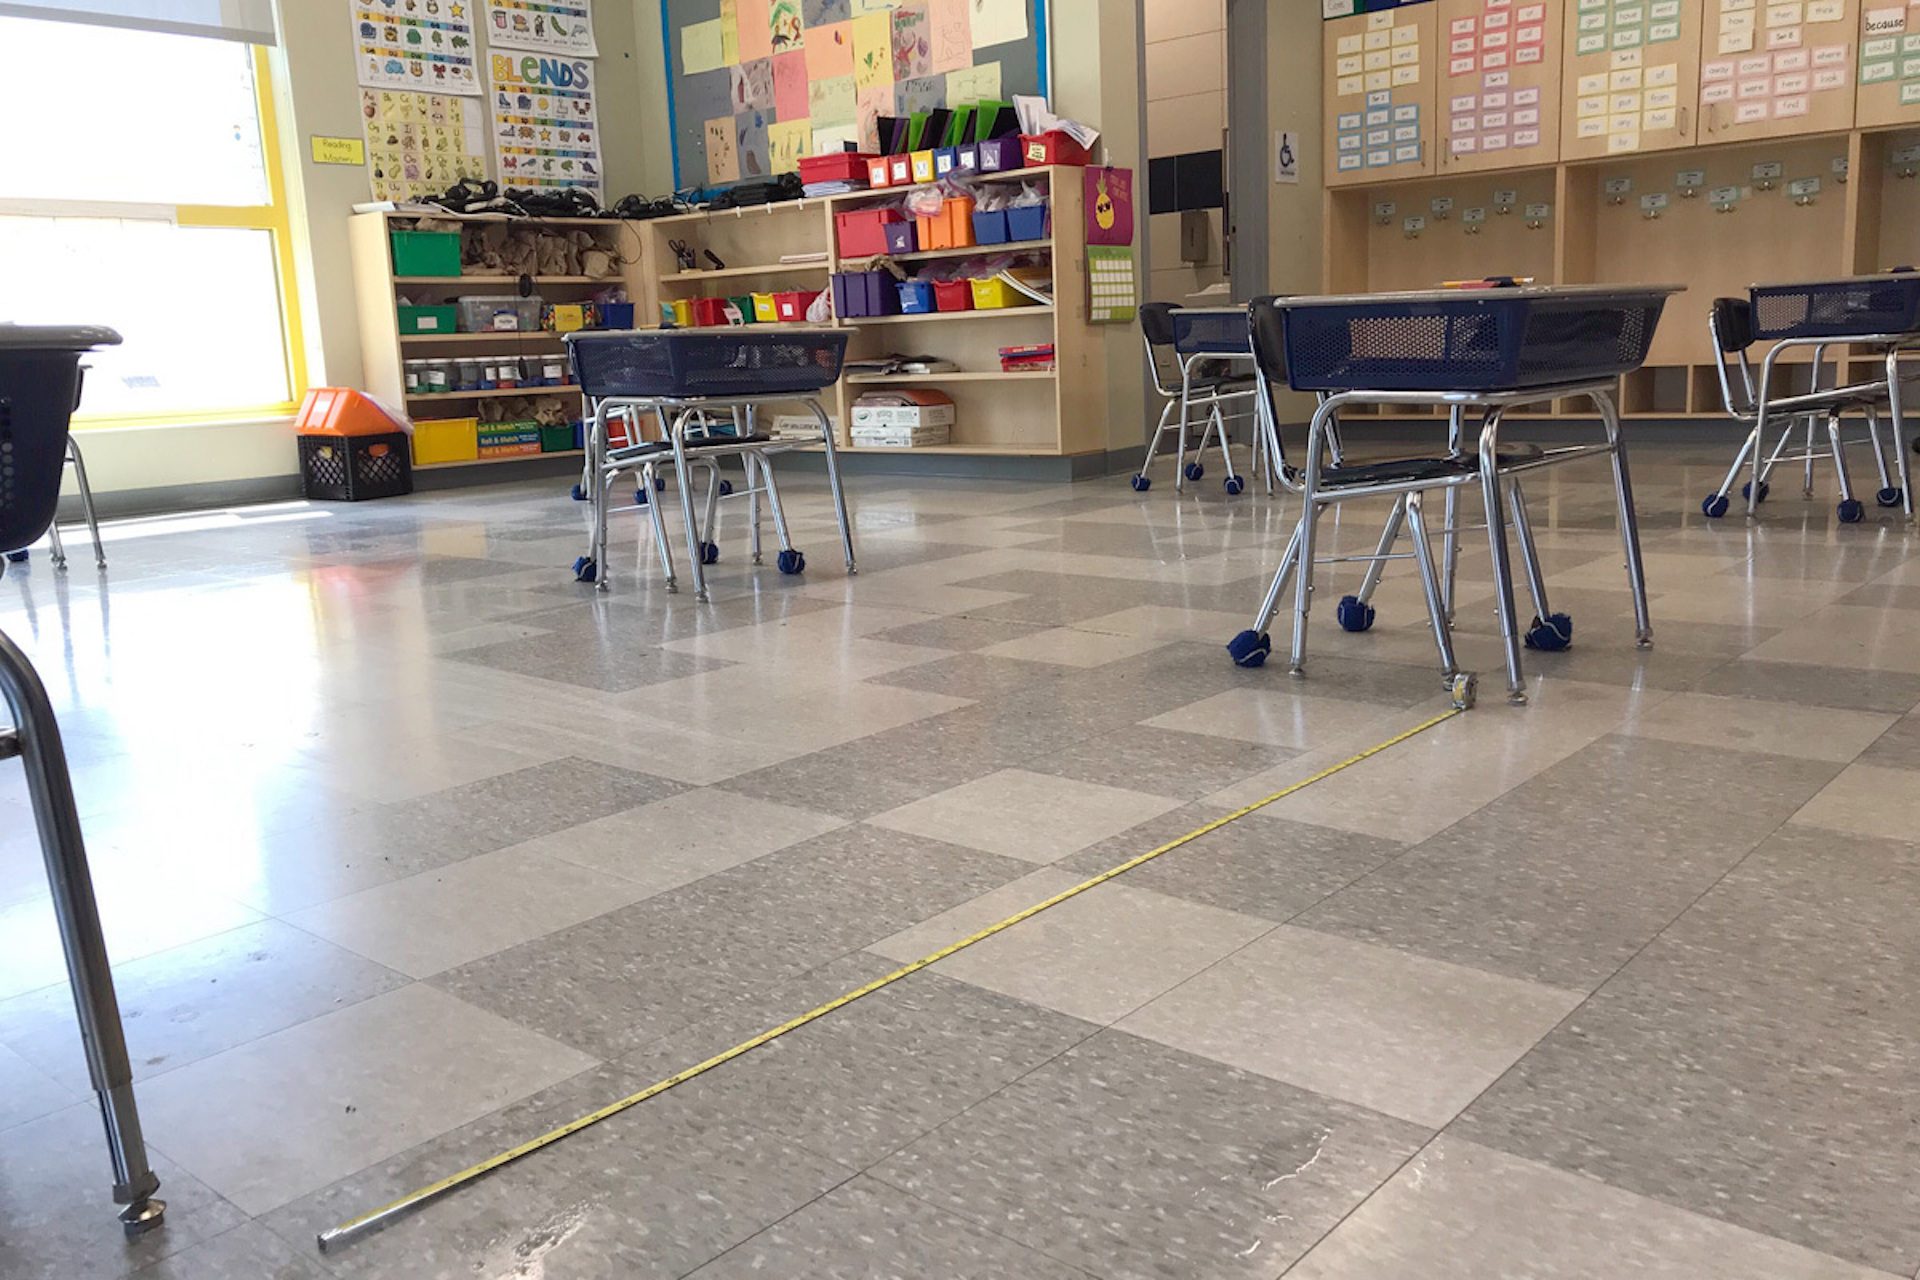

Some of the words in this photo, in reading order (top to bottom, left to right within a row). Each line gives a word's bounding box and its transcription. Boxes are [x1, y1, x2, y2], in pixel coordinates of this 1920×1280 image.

[1865, 16, 1904, 31] because
[1868, 40, 1892, 52] could
[1817, 51, 1841, 60] where
[1783, 57, 1798, 65] not
[1708, 66, 1729, 75] away
[1742, 62, 1765, 71] come
[1871, 66, 1886, 77] just
[1820, 74, 1837, 82] look
[1744, 84, 1764, 92] were
[1782, 80, 1802, 88] here
[431, 97, 441, 106] Ee
[1651, 94, 1669, 102] from
[1782, 101, 1799, 109] find
[322, 139, 352, 152] Reading
